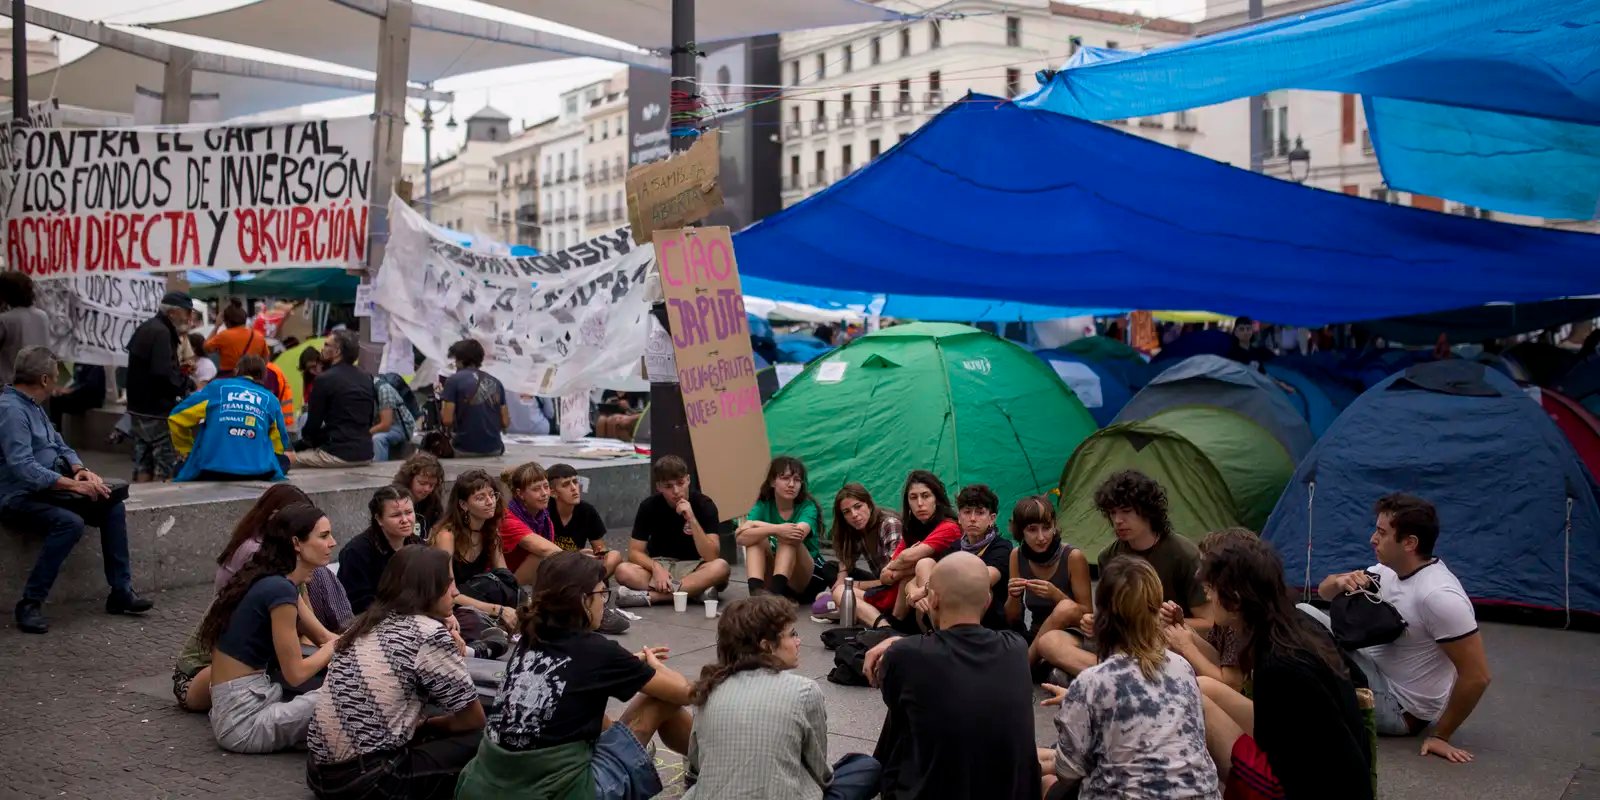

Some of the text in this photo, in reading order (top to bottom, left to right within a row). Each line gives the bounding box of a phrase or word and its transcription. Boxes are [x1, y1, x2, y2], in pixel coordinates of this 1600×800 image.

[12, 128, 140, 172] CONTRA
[157, 132, 193, 153] EL
[23, 170, 66, 213] LOS
[71, 156, 172, 214] FONDOS
[187, 156, 211, 210] DE
[220, 150, 371, 208] INVERSIÓN
[7, 208, 82, 276] ACCIÓN
[85, 210, 201, 272] DIRECTA
[207, 210, 229, 267] Y
[234, 198, 368, 265] OKUPACIÓN
[662, 233, 732, 287] CIAO
[669, 289, 745, 349] JAPUTA
[718, 356, 754, 385] FRUTA
